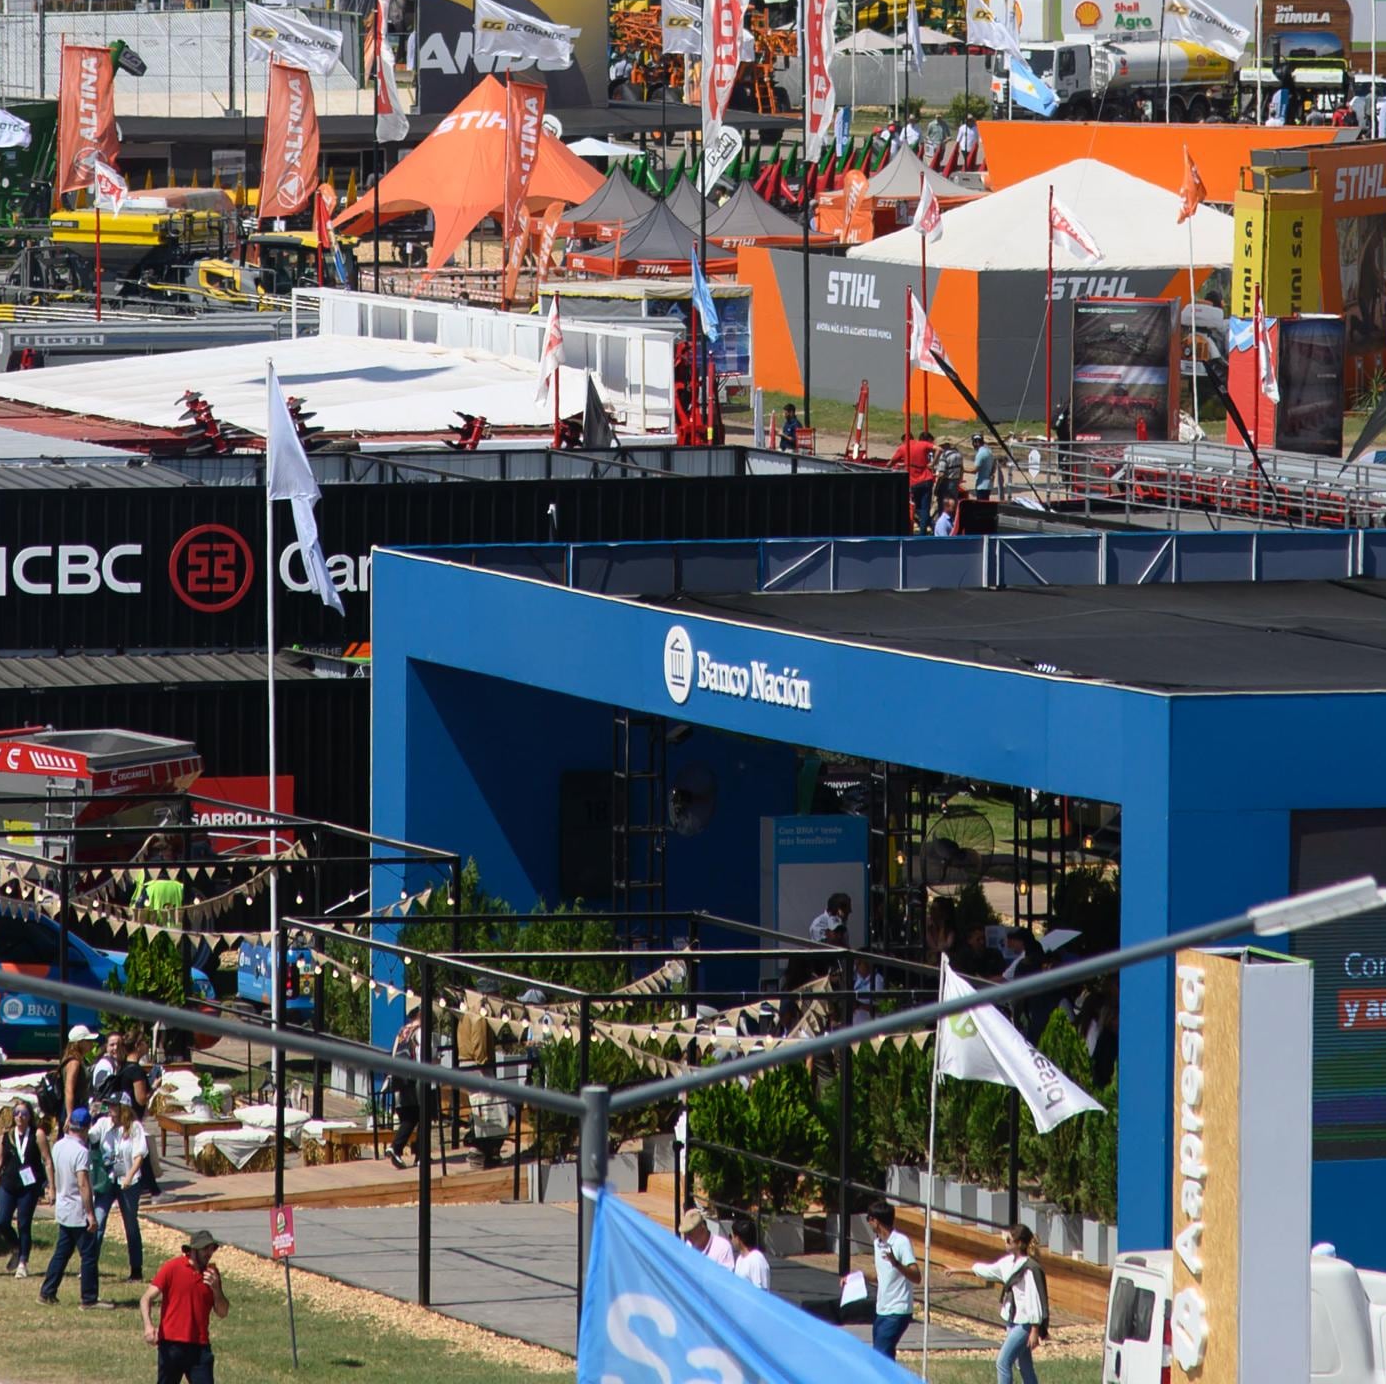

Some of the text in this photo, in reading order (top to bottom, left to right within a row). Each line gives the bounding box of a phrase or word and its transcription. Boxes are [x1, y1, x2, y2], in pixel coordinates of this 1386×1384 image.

[1114, 1, 1140, 13] Shell
[1276, 4, 1294, 13] Shell
[482, 20, 567, 42] DG DE GRANDE
[1115, 13, 1152, 30] Agro
[251, 27, 275, 39] DG
[79, 55, 99, 144] ALTINA
[283, 77, 304, 168] ALTINA
[433, 110, 509, 135] STIH
[635, 263, 673, 275] STIHL
[826, 270, 882, 309] STIHL
[1044, 275, 1137, 302] STIHL
[696, 651, 812, 710] Banco Nación
[778, 826, 794, 834] Con
[795, 835, 837, 845] beneficios
[26, 1004, 58, 1017] BNA
[1341, 997, 1359, 1024] y
[1175, 965, 1210, 1276] Aapresid
